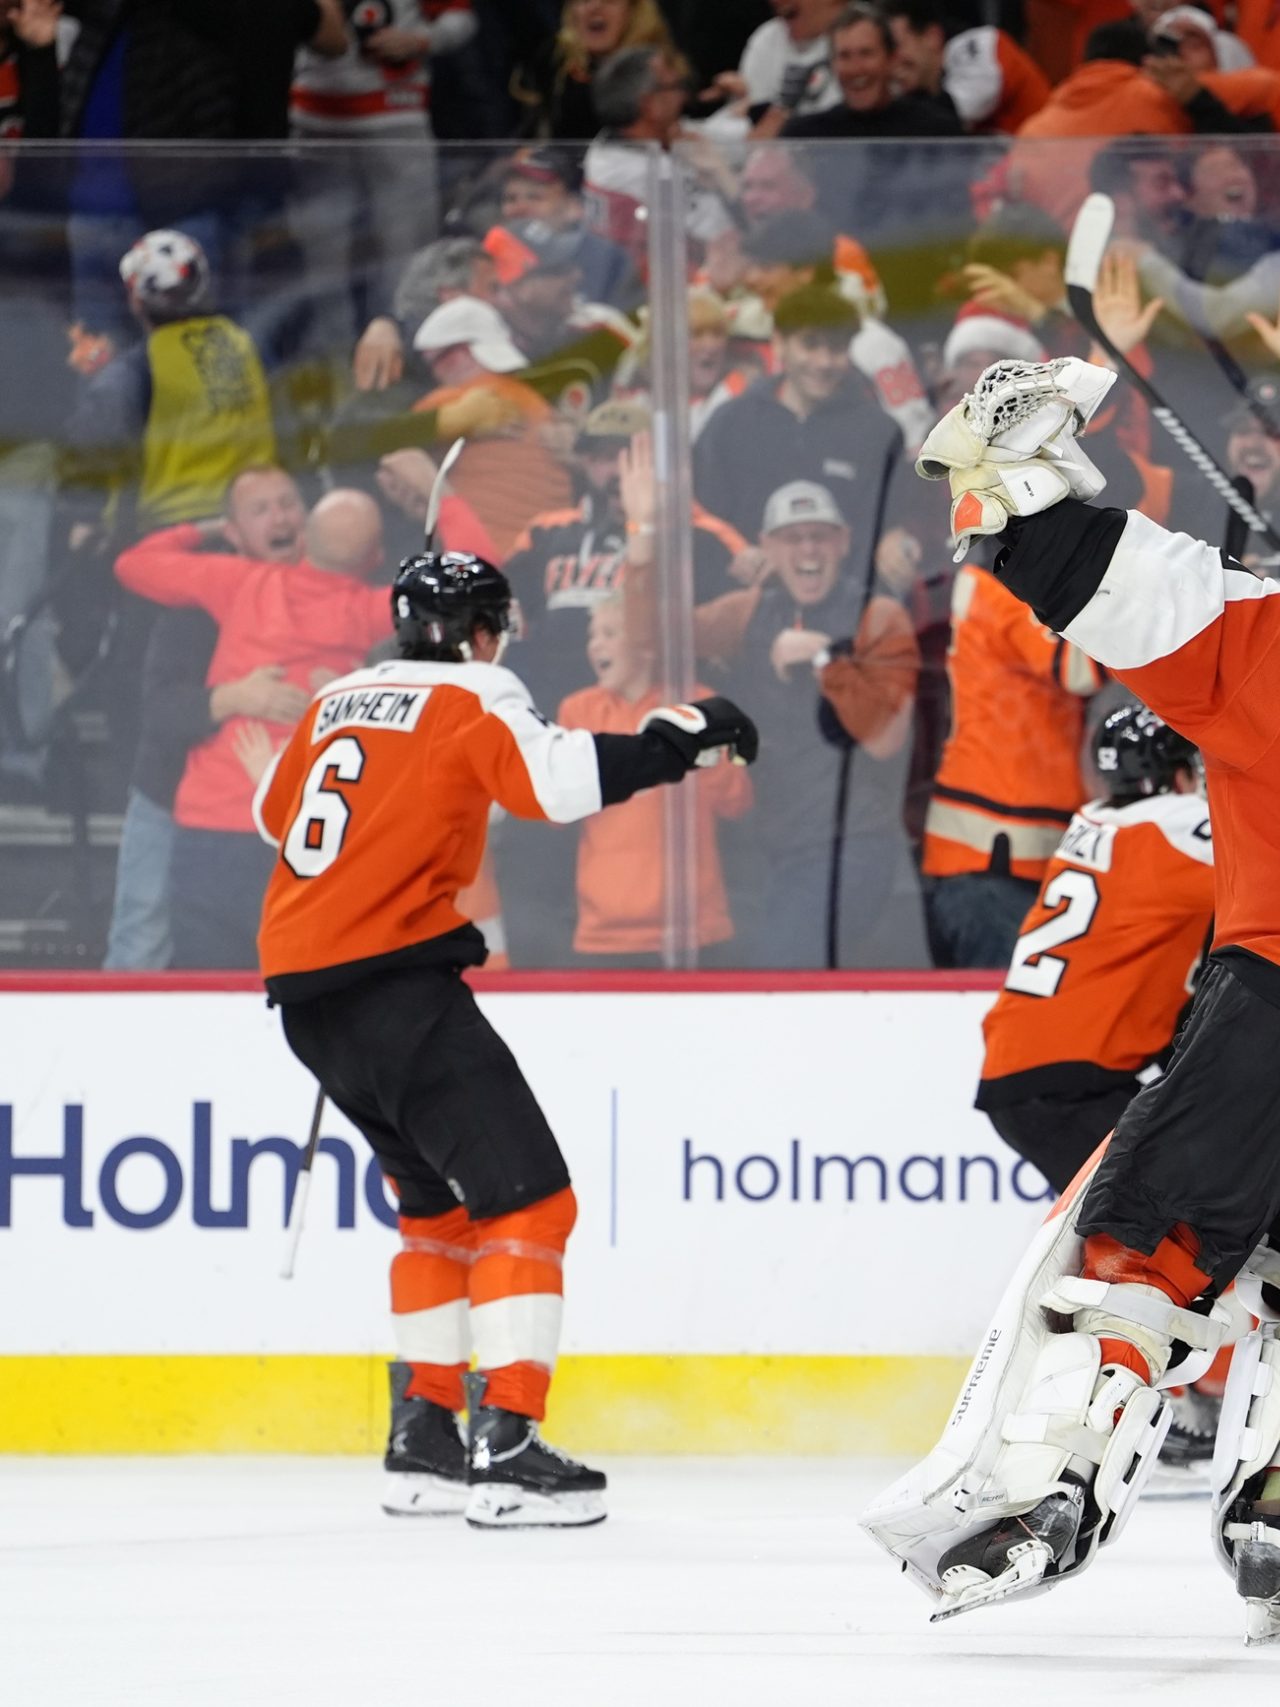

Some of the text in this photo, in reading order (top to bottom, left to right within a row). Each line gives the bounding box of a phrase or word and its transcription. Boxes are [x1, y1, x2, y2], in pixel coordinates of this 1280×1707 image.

[318, 692, 420, 735] SANHEIM
[282, 736, 366, 879] 6
[952, 1328, 1002, 1427] SUPREME
